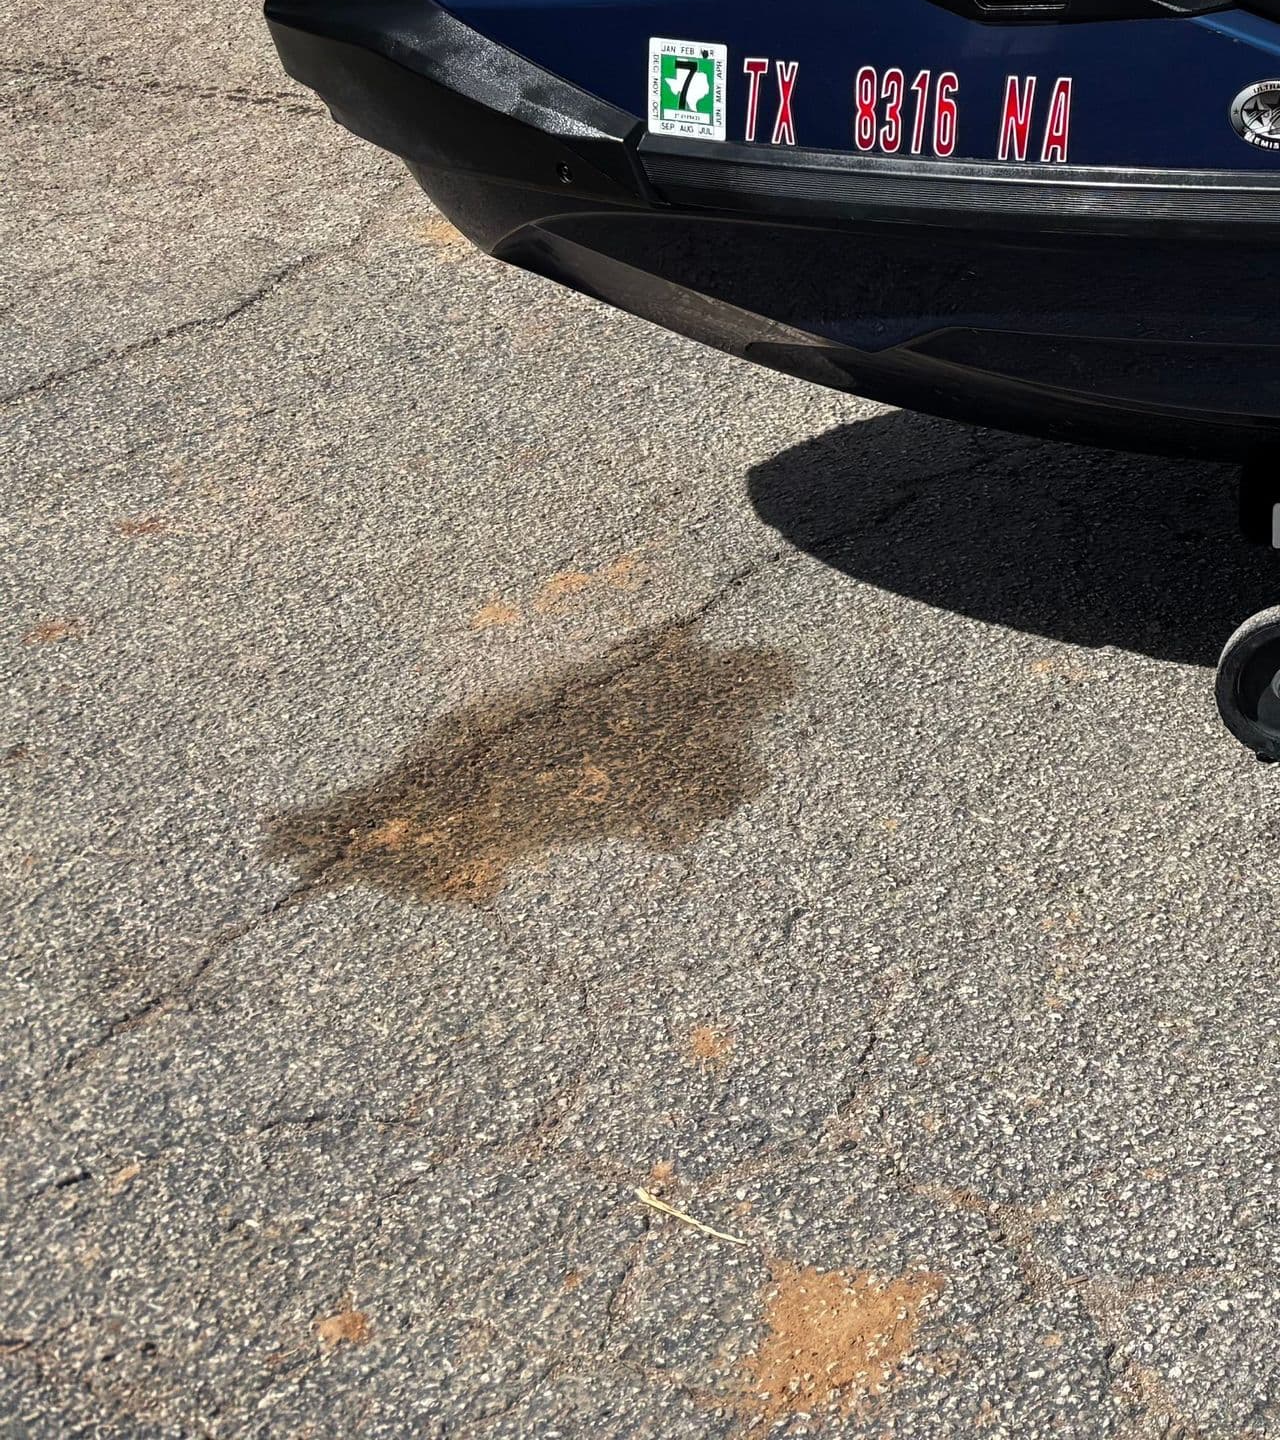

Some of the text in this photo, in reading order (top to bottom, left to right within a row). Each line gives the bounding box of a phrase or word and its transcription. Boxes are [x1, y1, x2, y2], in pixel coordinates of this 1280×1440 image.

[661, 45, 676, 54] JAN
[681, 46, 695, 55] FEB
[675, 60, 698, 110] 7
[744, 58, 1073, 163] TX 8316 NA
[661, 122, 713, 136] SEP AUG JUL
